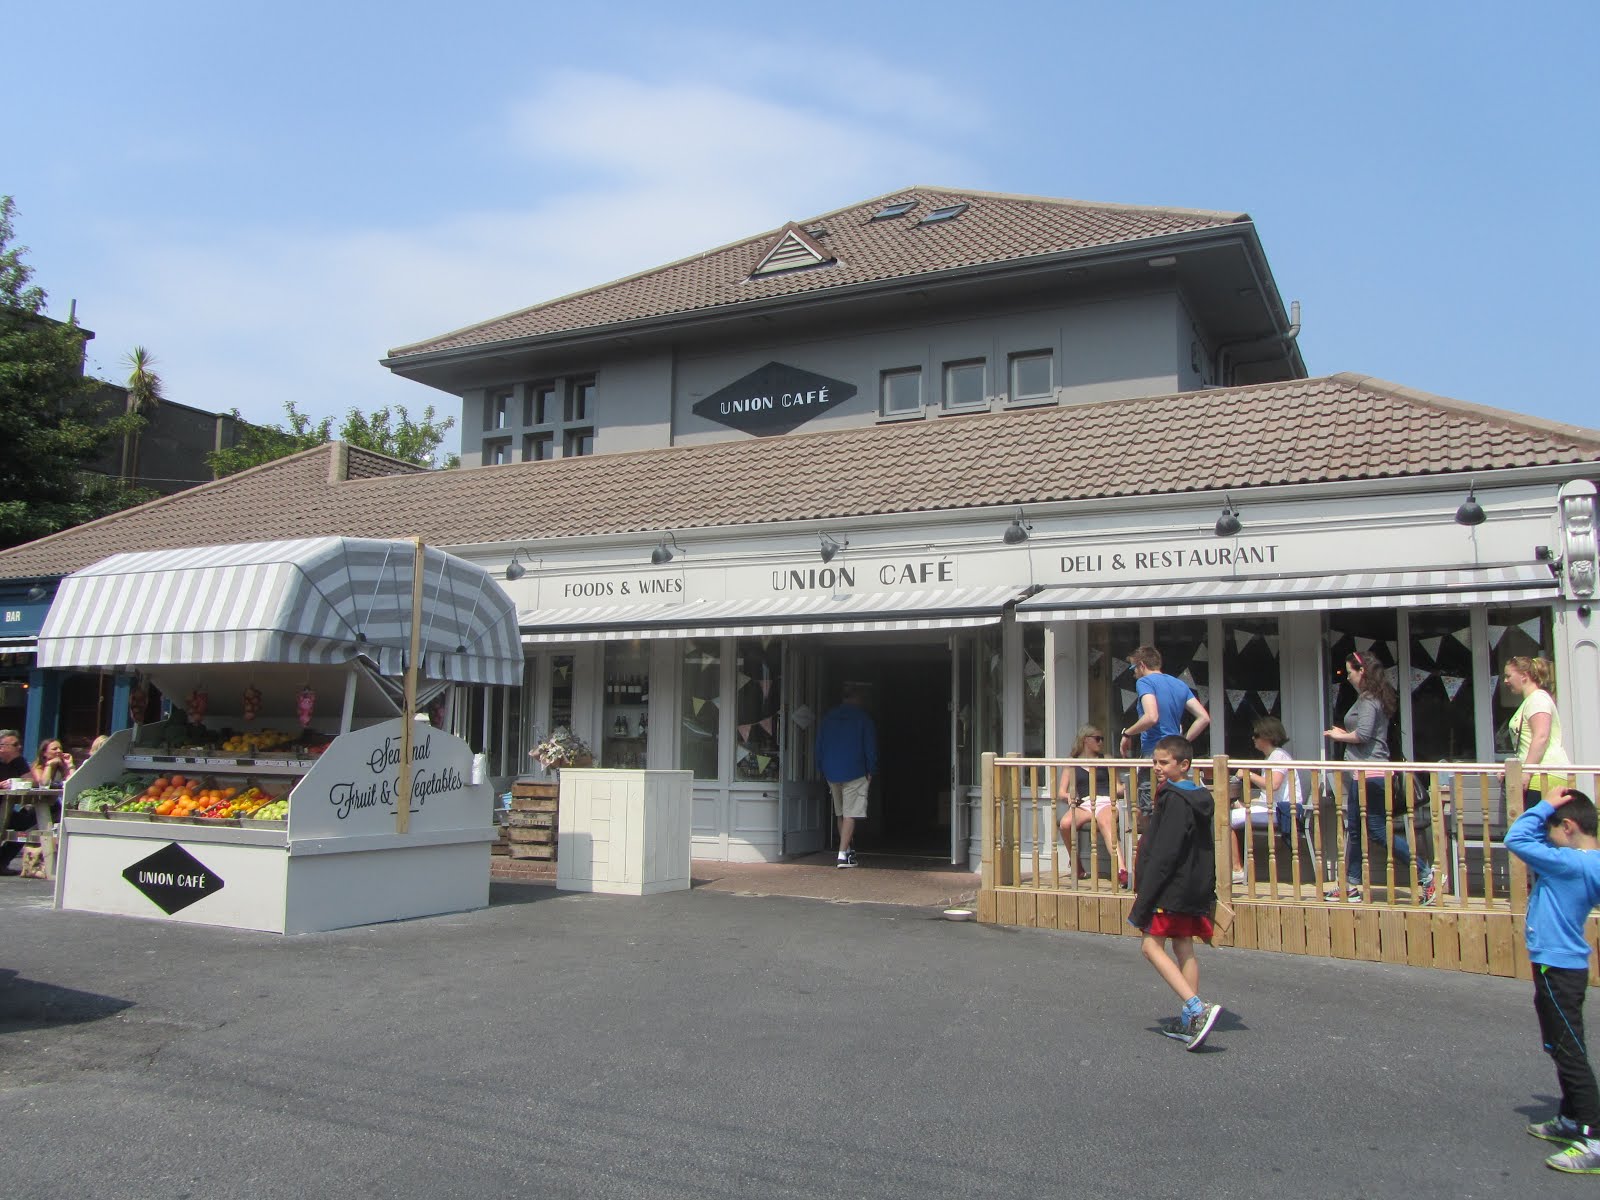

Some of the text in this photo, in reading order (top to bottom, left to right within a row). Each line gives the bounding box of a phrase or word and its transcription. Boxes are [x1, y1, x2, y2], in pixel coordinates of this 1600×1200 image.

[720, 386, 829, 415] UNION CAFÉ
[772, 555, 953, 591] UNION CAFÉ
[1060, 545, 1279, 573] DELI & RESTAURANT
[564, 578, 683, 598] FOODS & WINES
[5, 611, 21, 622] BAR
[366, 734, 431, 774] Seanal
[329, 781, 377, 819] Fruit
[380, 780, 393, 805] &
[139, 870, 206, 888] UNION CAFÉ
